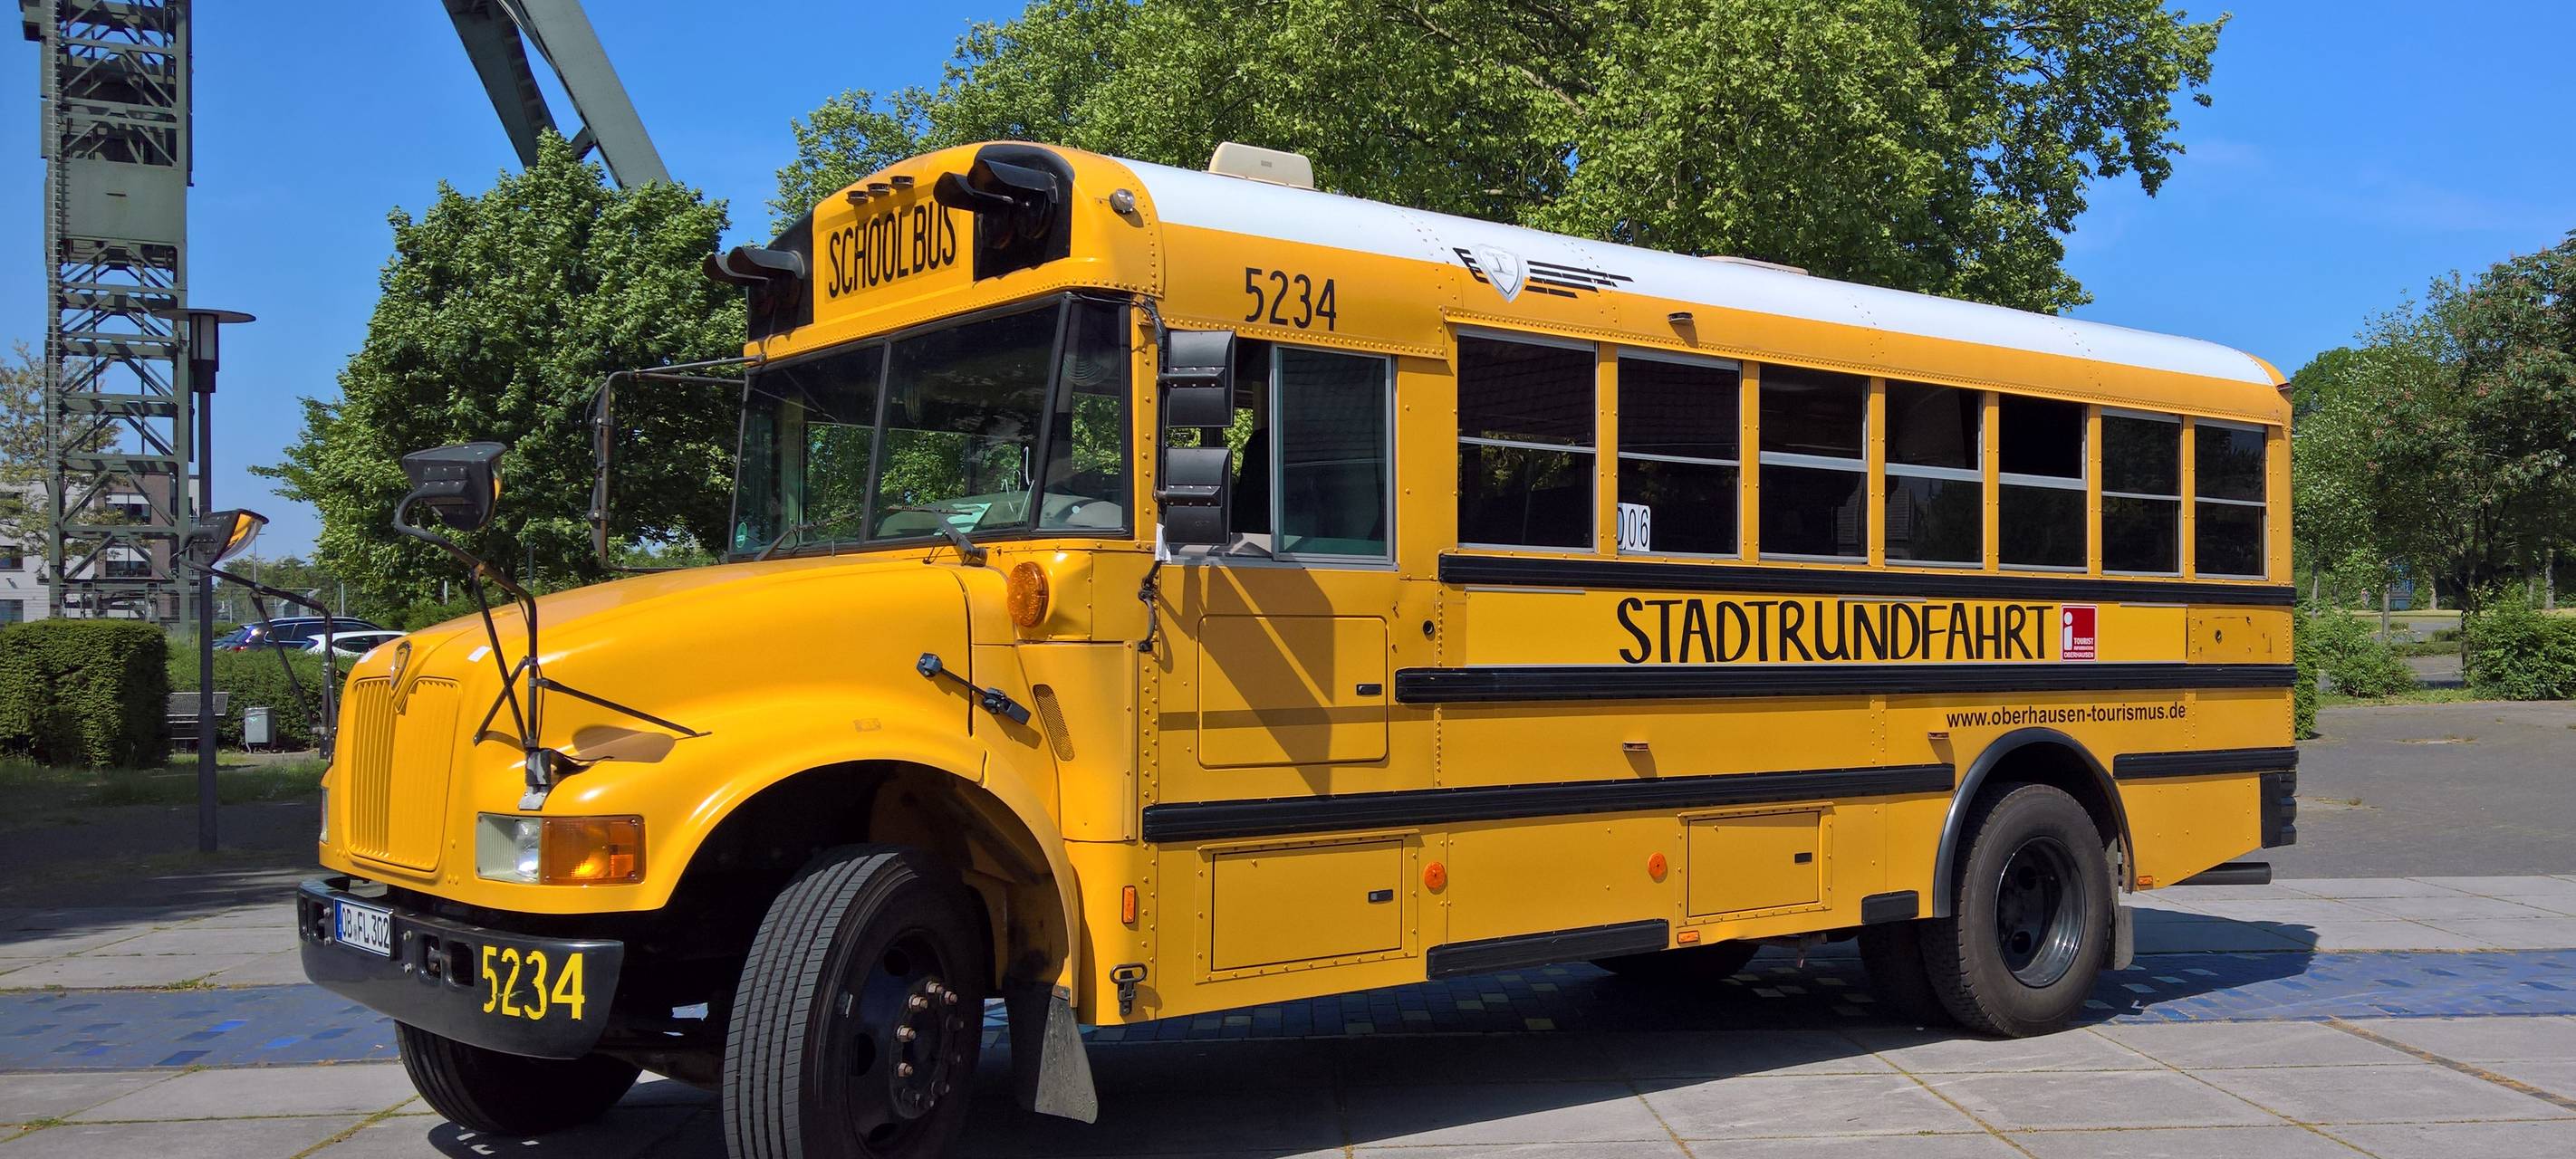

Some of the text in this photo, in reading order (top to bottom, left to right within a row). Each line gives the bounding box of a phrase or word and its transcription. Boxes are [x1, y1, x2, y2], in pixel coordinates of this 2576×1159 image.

[828, 195, 956, 297] SCHOOL BUS
[1245, 267, 1336, 331] 5234
[1619, 597, 2052, 663] STADTRUNDFAHRT
[2073, 637, 2094, 646] TOURIST
[1946, 701, 2187, 728] www.oberhausen-tourismus.de
[341, 907, 352, 938] OB
[371, 915, 389, 949] 302
[482, 945, 585, 1020] 5234
